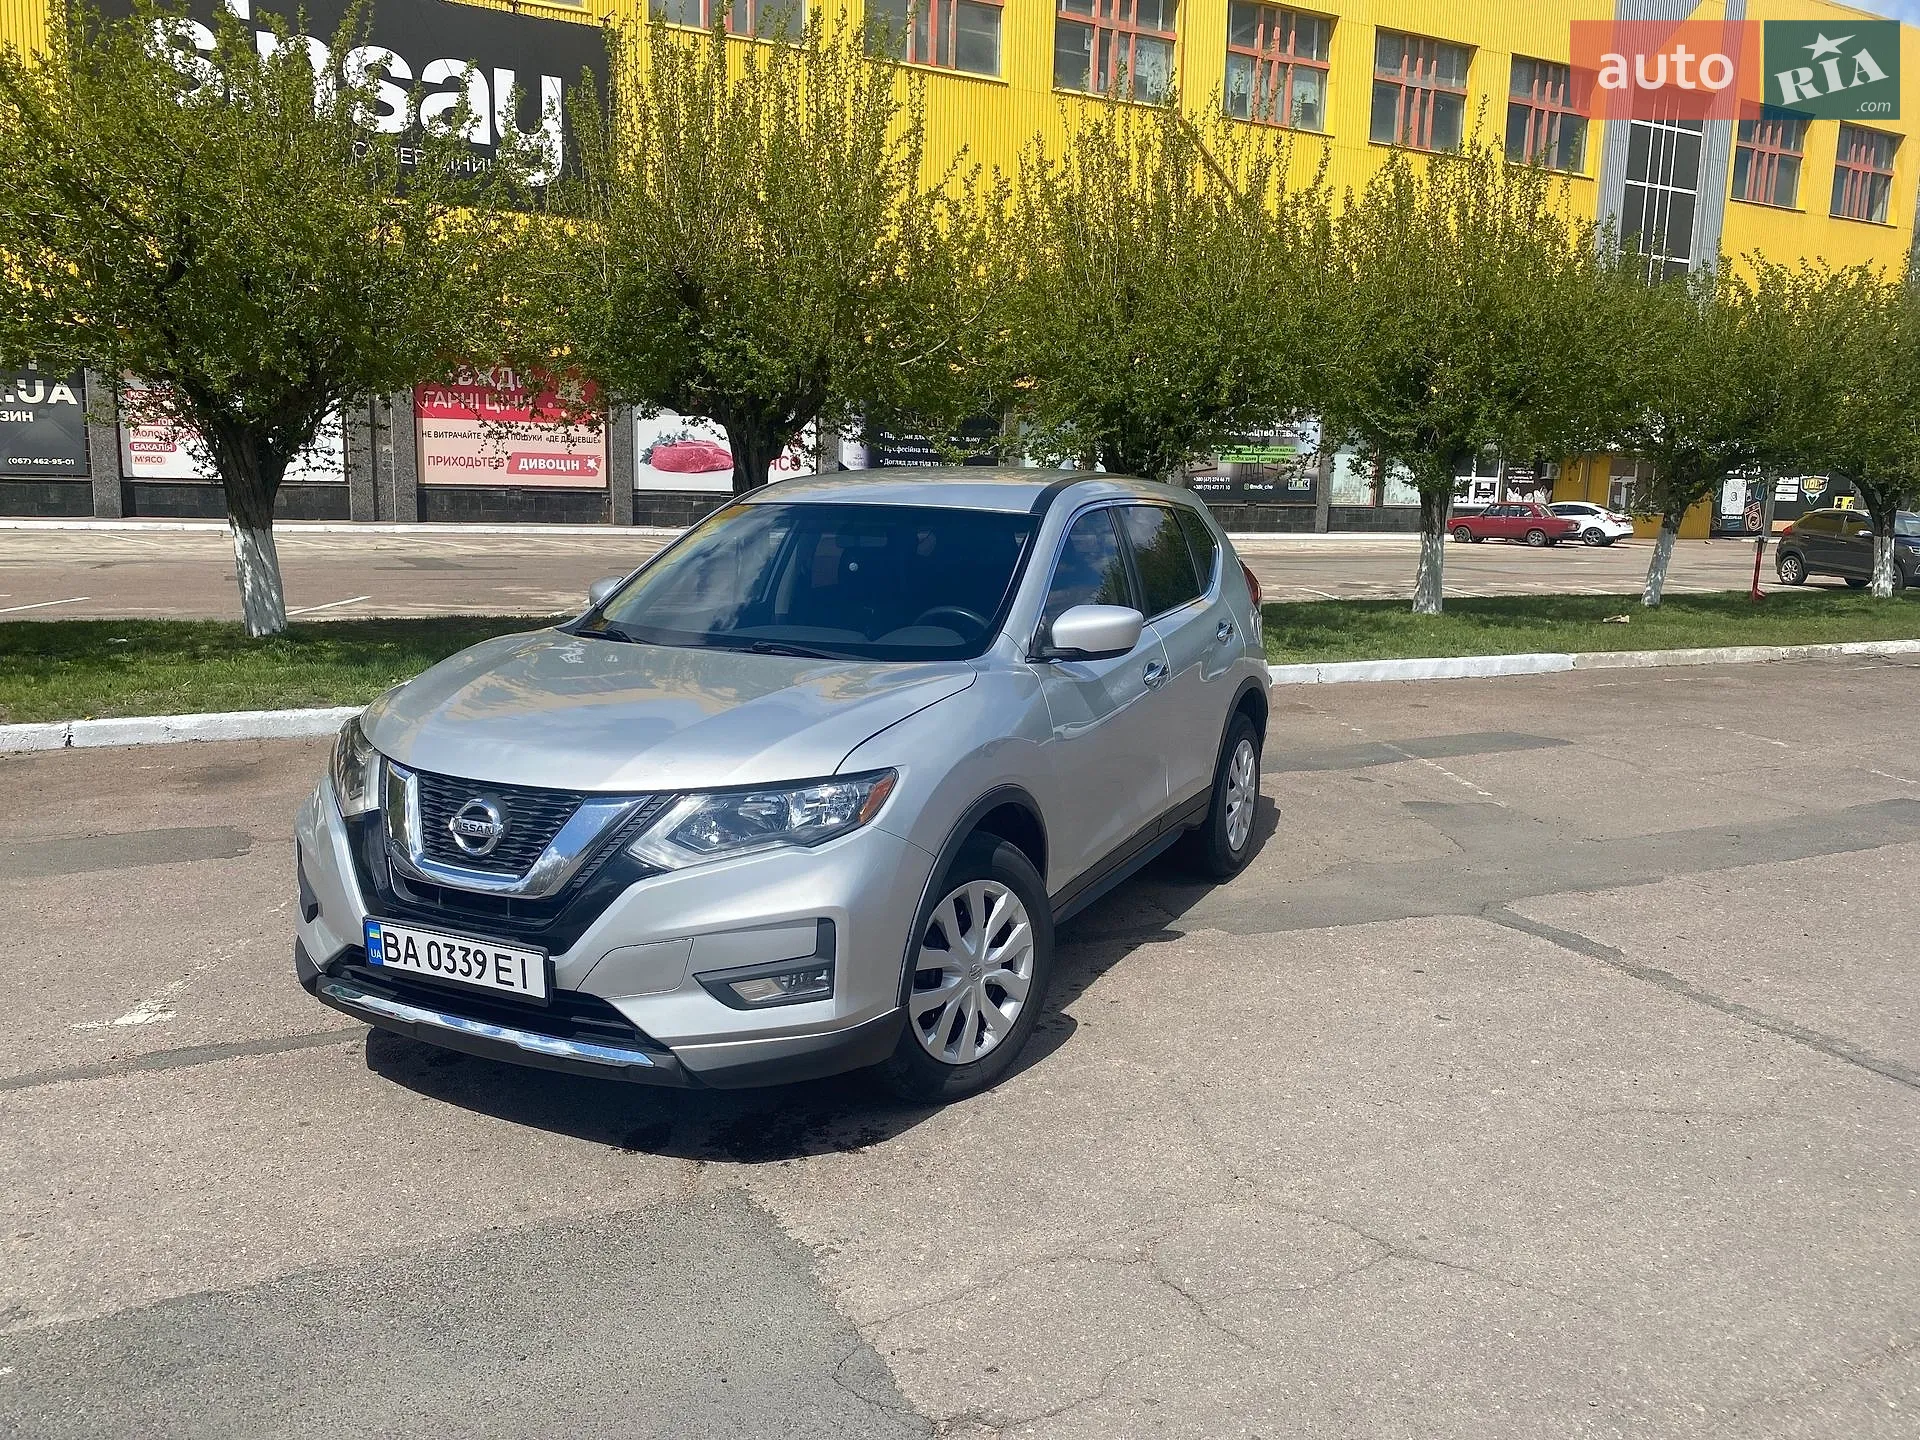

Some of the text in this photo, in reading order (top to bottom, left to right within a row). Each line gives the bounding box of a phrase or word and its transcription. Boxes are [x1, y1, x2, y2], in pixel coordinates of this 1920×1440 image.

[423, 390, 480, 409] ГАРНІ
[433, 430, 482, 439] ВИТРАЧАЙТЕ
[511, 432, 543, 441] ПОШУКИ
[133, 443, 173, 451] БАКАЛІЯ
[8, 457, 75, 466] (067) 462-95-01
[427, 455, 494, 469] ПРИХОДЬТЕ
[518, 458, 580, 472] ДИВОЦІН
[453, 819, 495, 835] NISSAN
[370, 948, 382, 959] UA
[383, 931, 421, 968] BA
[427, 940, 487, 980] 0339
